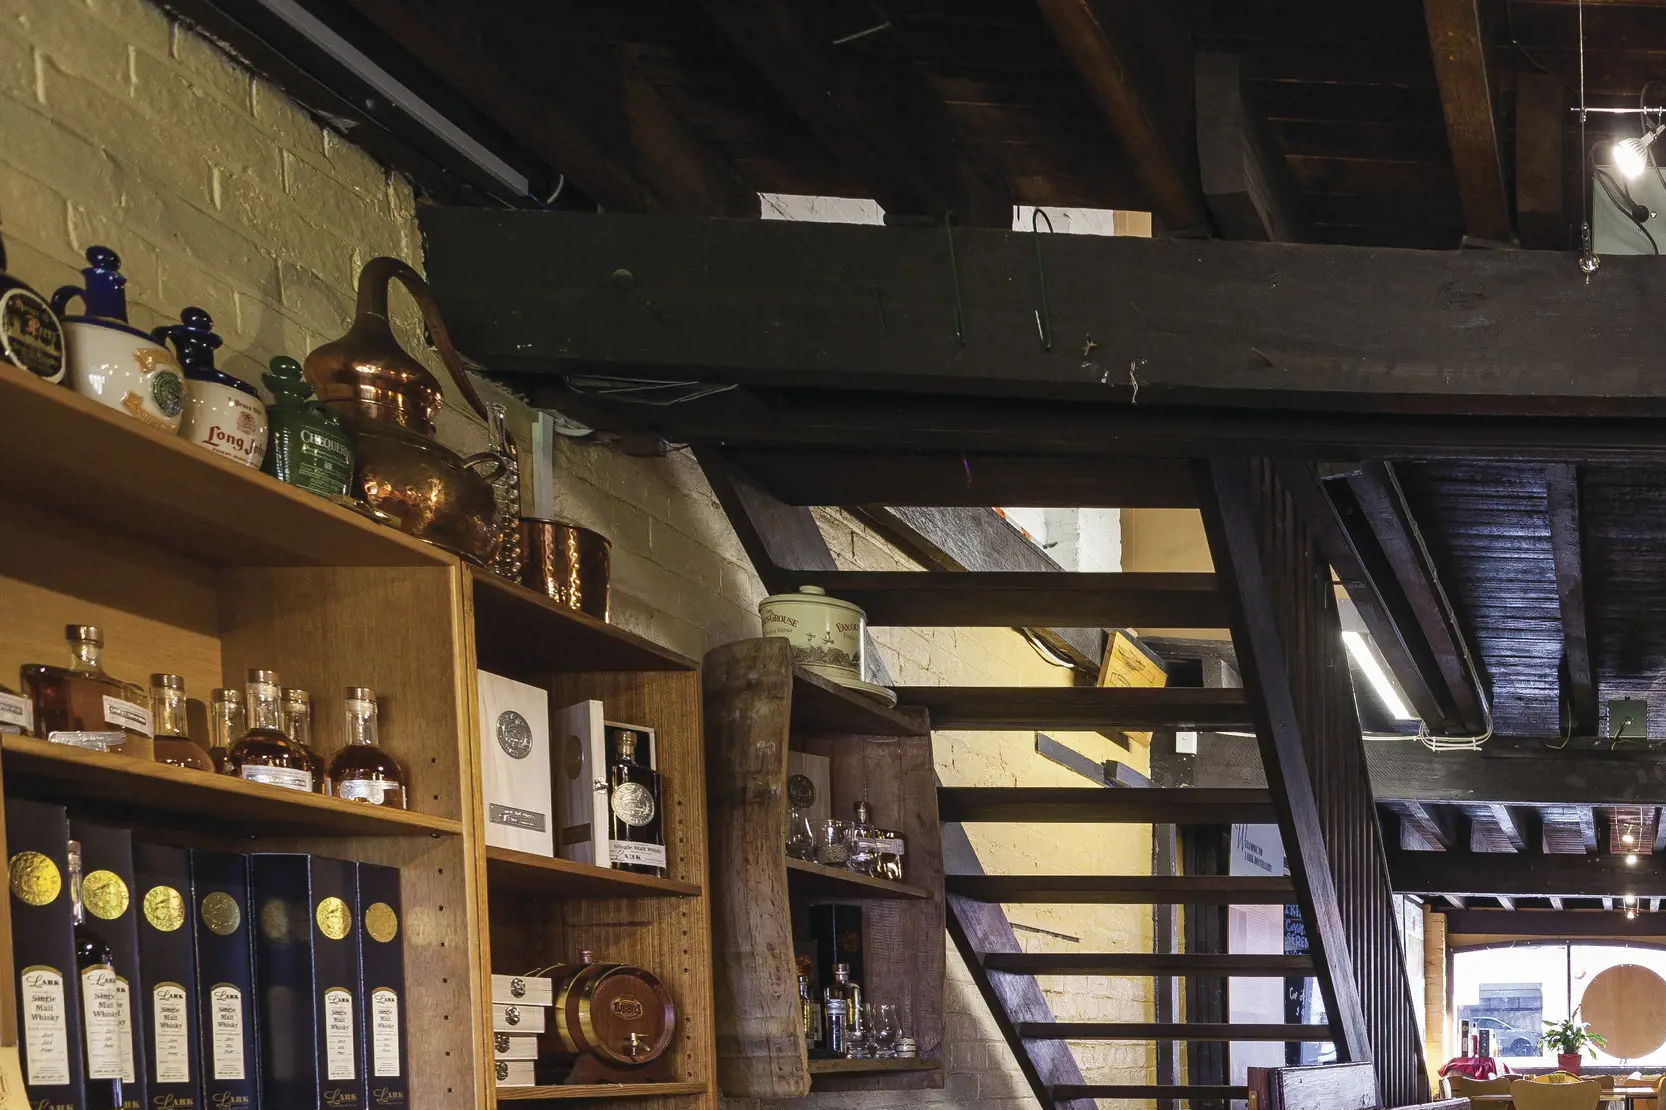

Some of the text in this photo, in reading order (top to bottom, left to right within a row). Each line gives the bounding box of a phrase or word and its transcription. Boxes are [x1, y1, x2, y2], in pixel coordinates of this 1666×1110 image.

[202, 425, 245, 451] Long
[770, 613, 798, 627] GROUSE
[26, 975, 60, 988] LARK
[157, 990, 184, 1001] LARK
[215, 991, 239, 1001] LARK
[328, 994, 350, 1004] LARK
[375, 994, 395, 1004] LARK
[32, 1014, 60, 1022] Whisky
